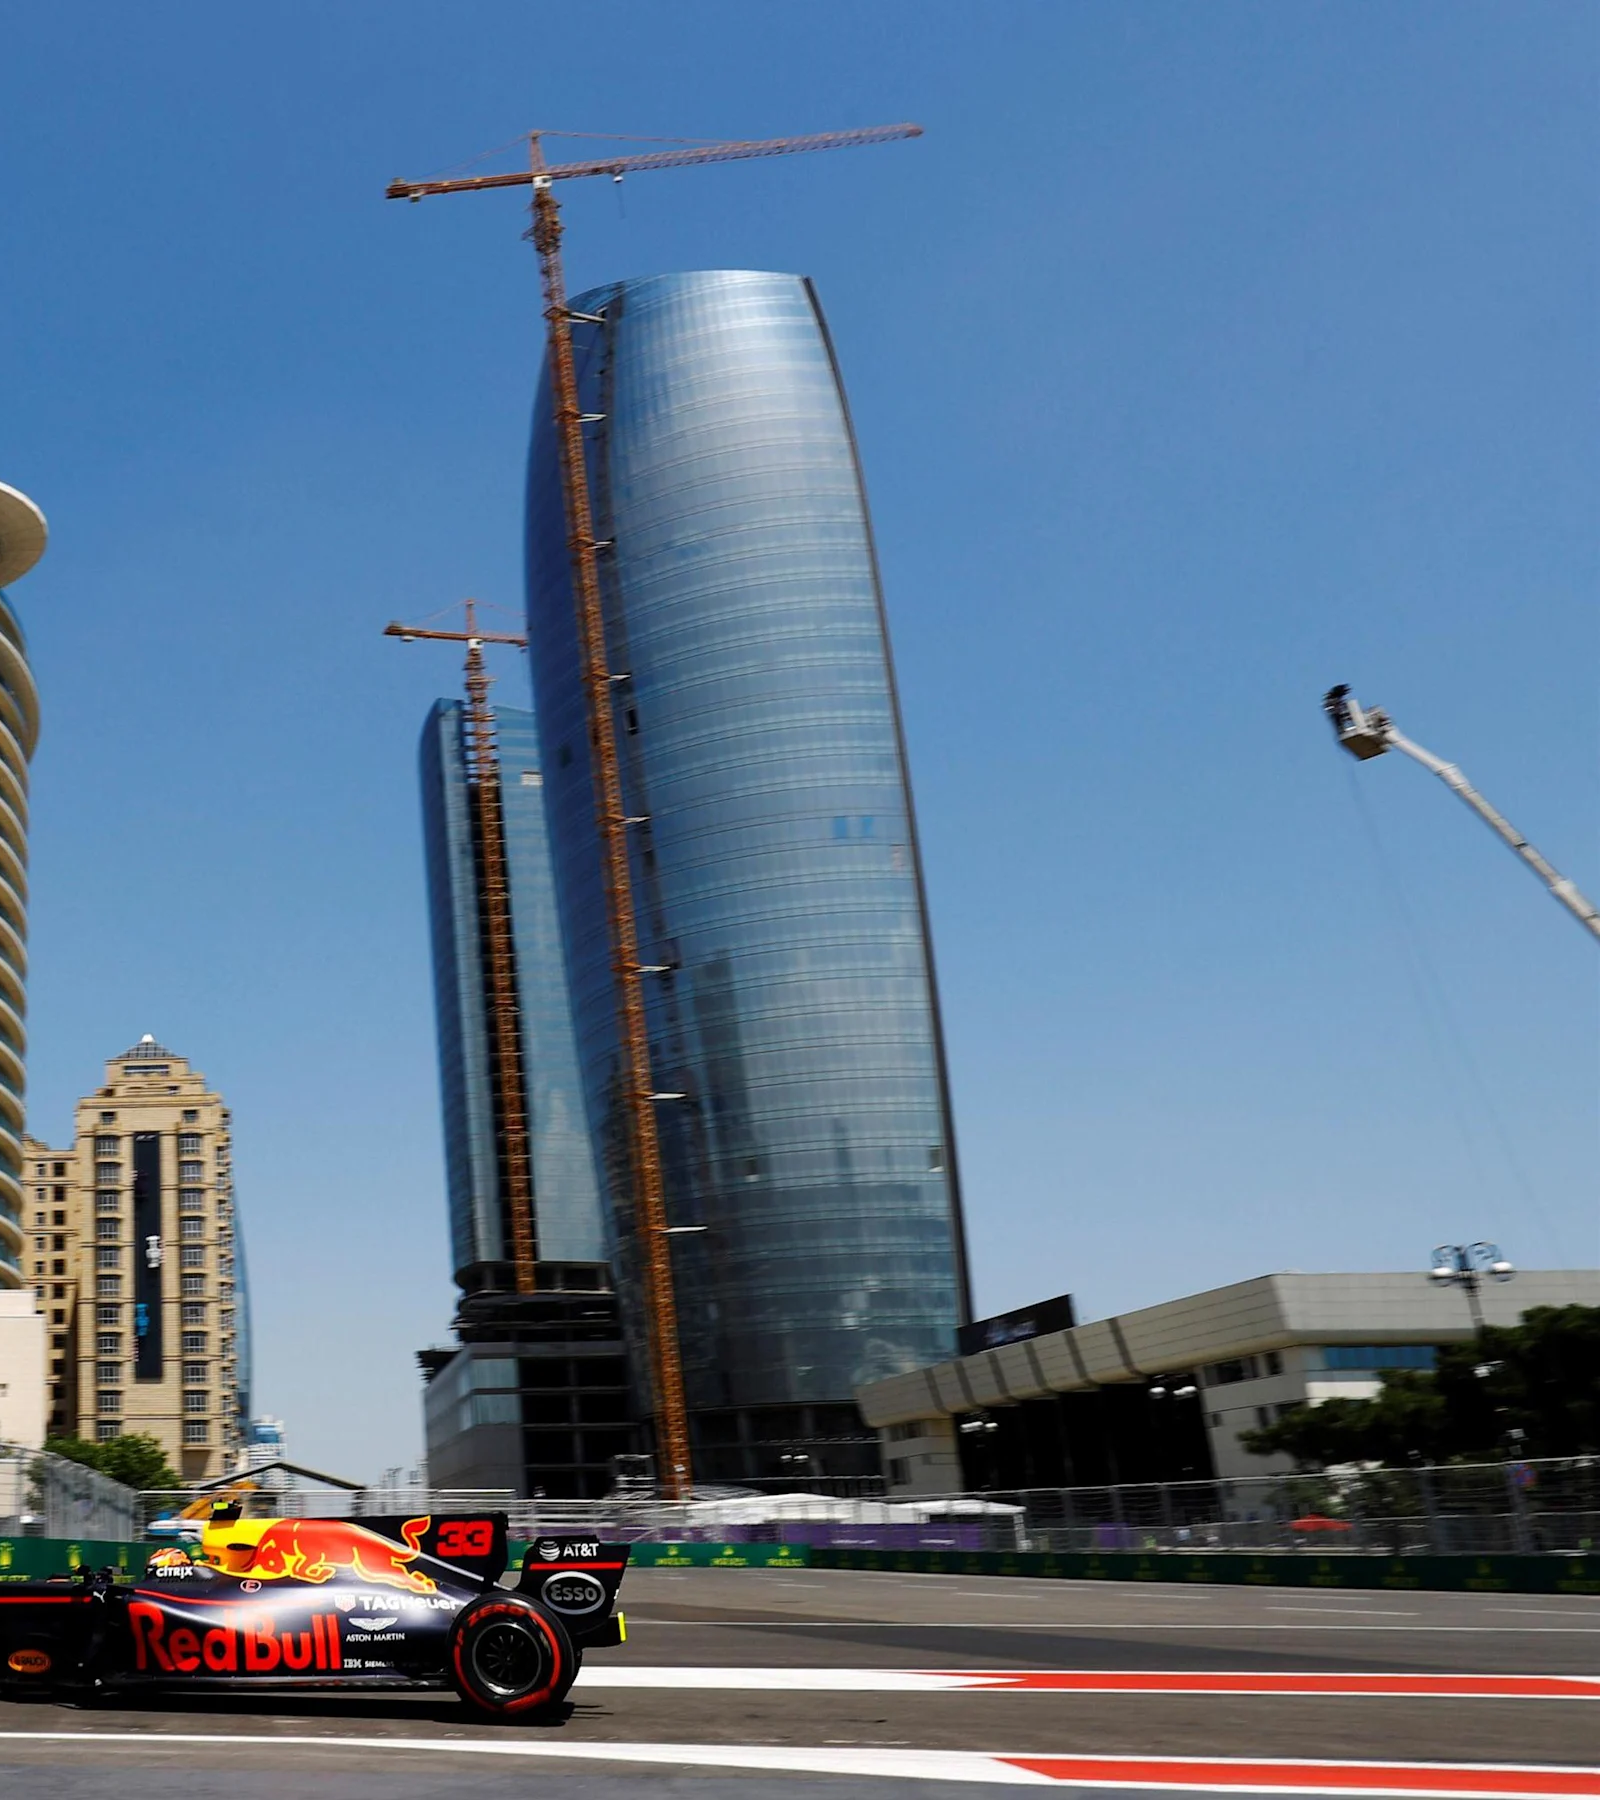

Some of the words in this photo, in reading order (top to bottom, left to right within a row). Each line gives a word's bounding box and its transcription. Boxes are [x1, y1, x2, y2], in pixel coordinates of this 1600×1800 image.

[436, 1520, 494, 1557] 33
[562, 1543, 600, 1558] AT&T
[345, 1633, 371, 1642] ASTON
[373, 1632, 406, 1642] MARTIN
[343, 1658, 362, 1669] IBM
